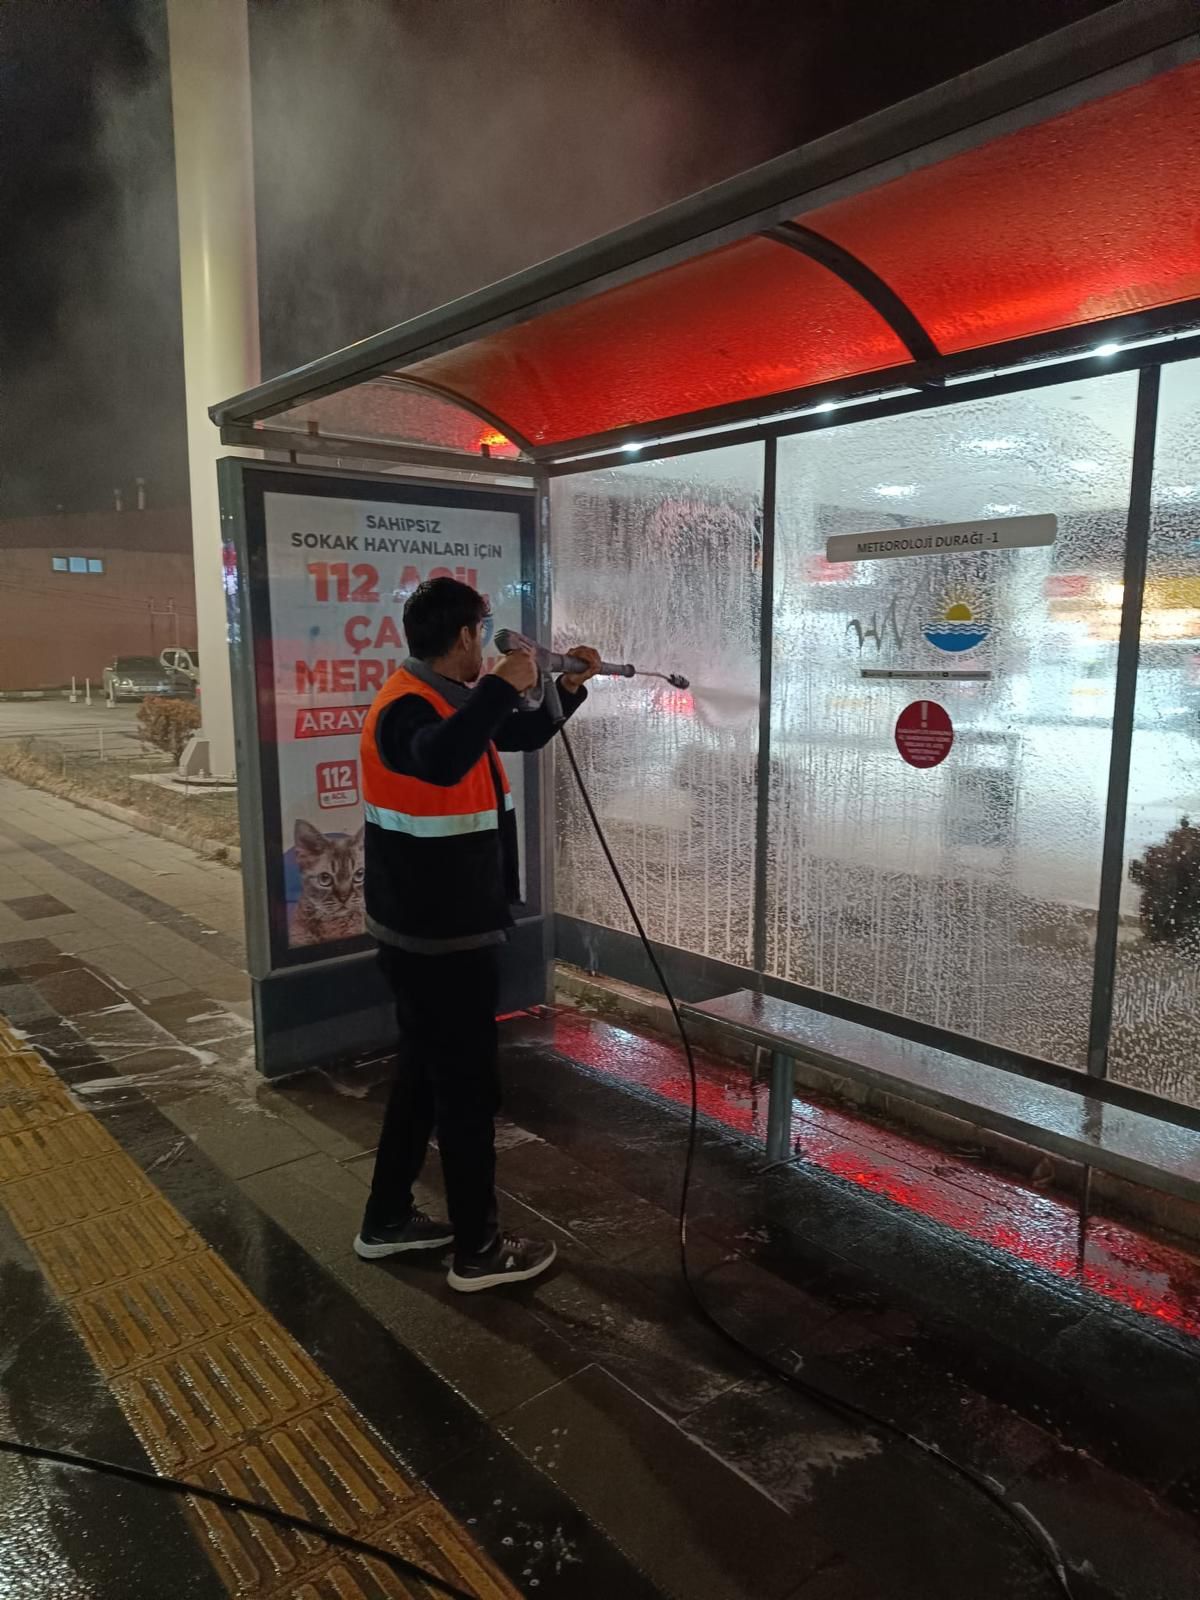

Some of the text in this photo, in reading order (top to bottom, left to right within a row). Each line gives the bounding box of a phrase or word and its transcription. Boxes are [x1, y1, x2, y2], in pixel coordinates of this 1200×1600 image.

[366, 515, 441, 534] SAHİPSİZ
[291, 533, 502, 560] SOKAK HAYVANLARI İÇİN
[857, 536, 933, 553] METEOROLOJİ
[935, 531, 984, 548] DURAĞI
[307, 561, 379, 603] 112
[344, 616, 402, 655] ÇA
[301, 709, 368, 732] ARAY
[322, 765, 352, 789] 112
